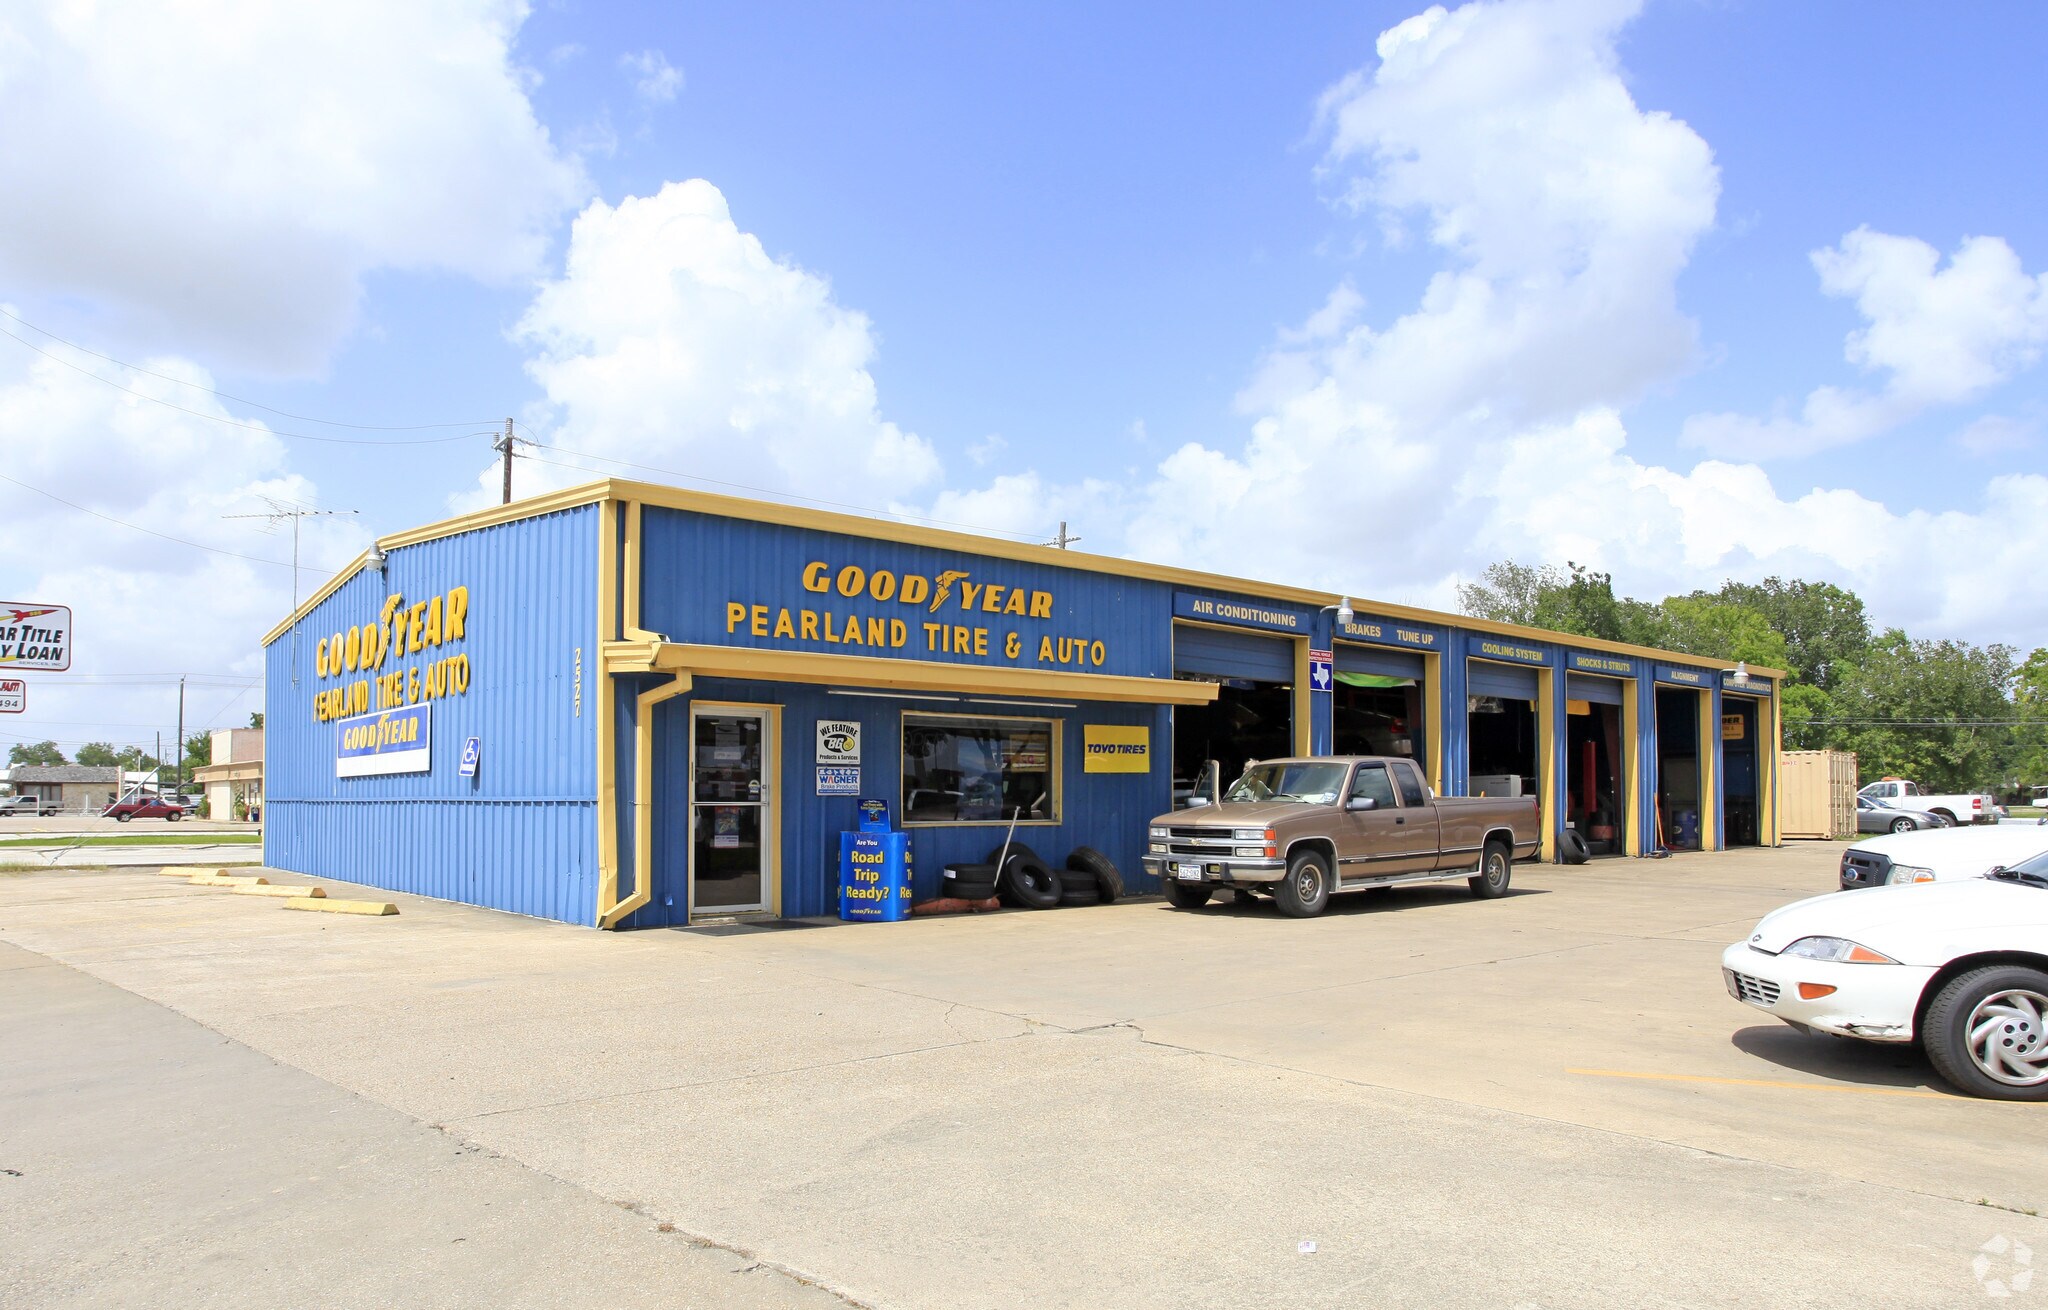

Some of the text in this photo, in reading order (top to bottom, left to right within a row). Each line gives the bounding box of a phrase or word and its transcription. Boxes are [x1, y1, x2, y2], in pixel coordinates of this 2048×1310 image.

[802, 561, 1053, 618] GOODYEAR
[1193, 600, 1296, 627] AIR CONDITIONING
[21, 624, 63, 643] TITLE
[726, 602, 1106, 666] PEARLAND TIRE & AUTO
[1345, 624, 1433, 645] BRAKES TUNE UP
[16, 642, 63, 661] LOAN
[1482, 642, 1543, 662] COOLING SYSTEM
[1576, 656, 1630, 673] SHOCKS & STRUTS
[376, 670, 403, 709] TIRE
[408, 667, 420, 704] &
[424, 653, 469, 700] AUTO
[1671, 670, 1699, 683] ALIGNMENT
[1746, 681, 1771, 692] DIAGNOSTICS
[343, 716, 418, 752] GOODYEAR
[820, 724, 858, 737] WE FEATURE
[828, 737, 844, 749] BG
[1088, 744, 1146, 754] TOYO TIRES
[851, 851, 884, 864] Road
[854, 868, 880, 884] Trip
[846, 886, 890, 902] Ready?
